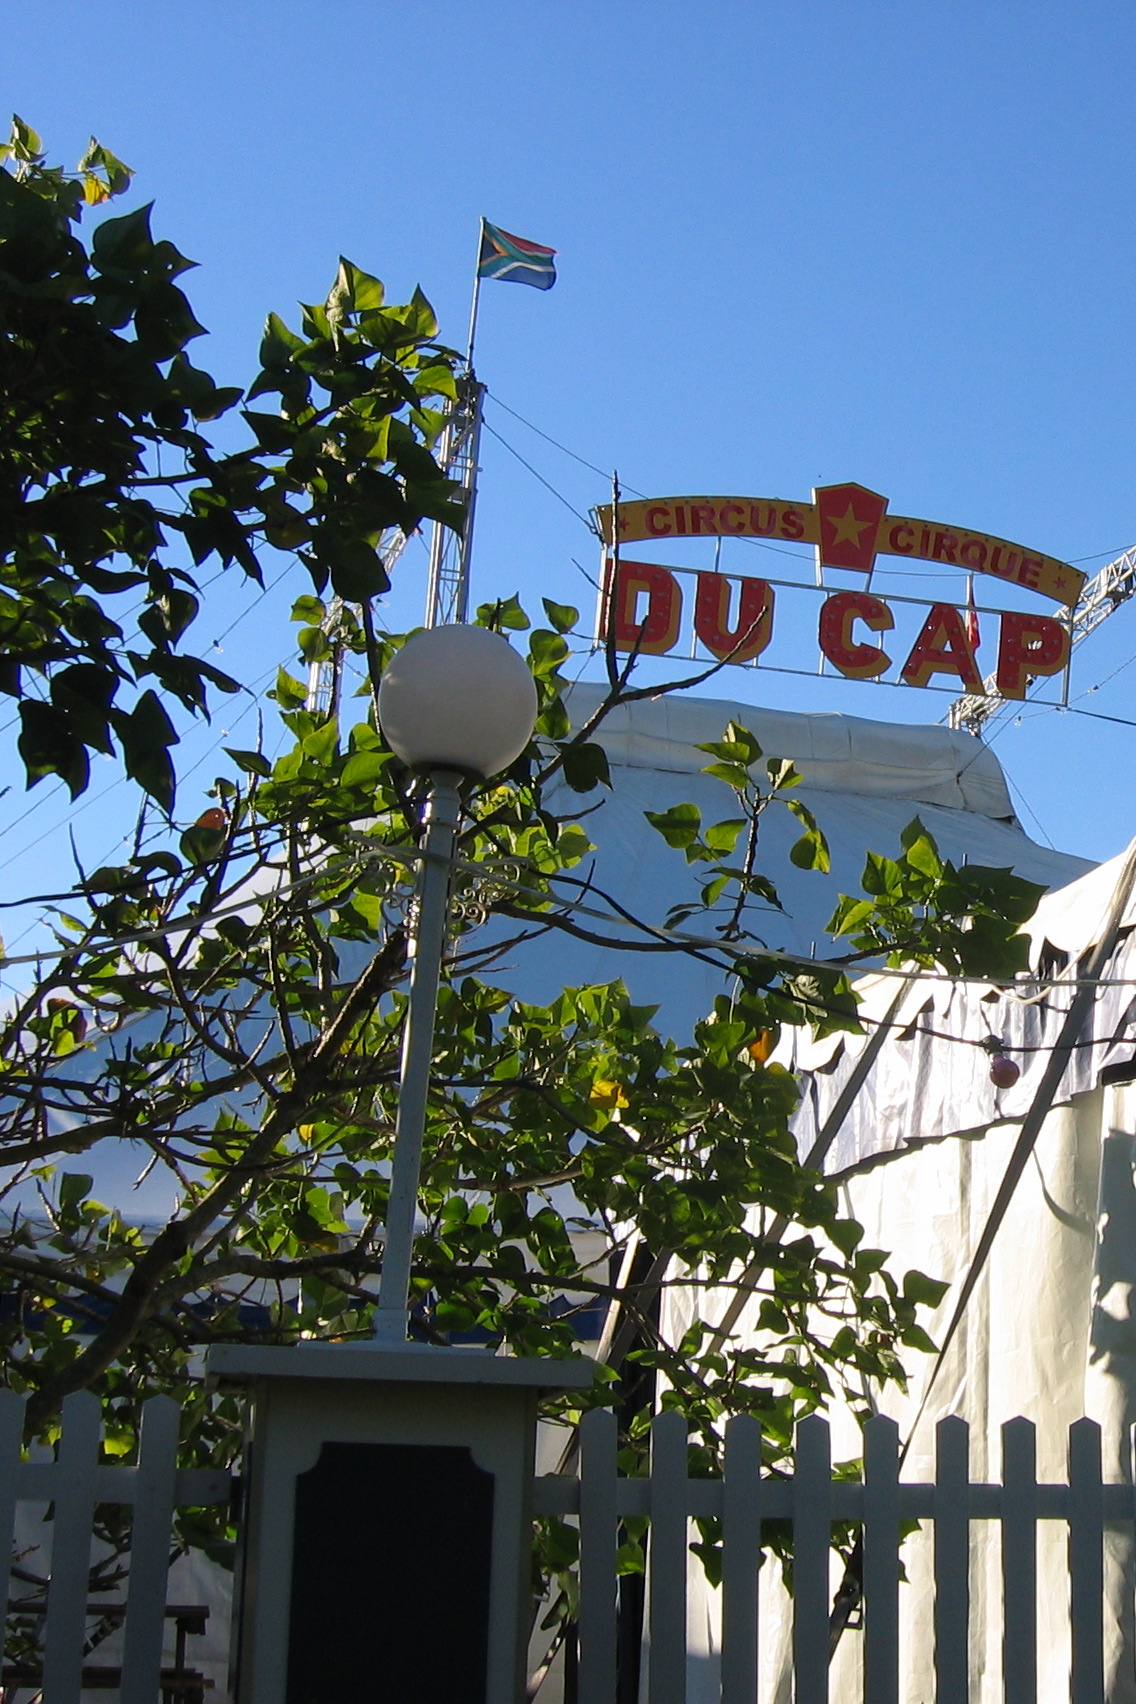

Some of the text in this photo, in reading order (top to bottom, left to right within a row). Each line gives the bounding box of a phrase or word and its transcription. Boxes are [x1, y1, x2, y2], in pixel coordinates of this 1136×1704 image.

[645, 504, 1043, 589] CIRCUS CIRQUE
[602, 558, 1070, 700] DU CAP
